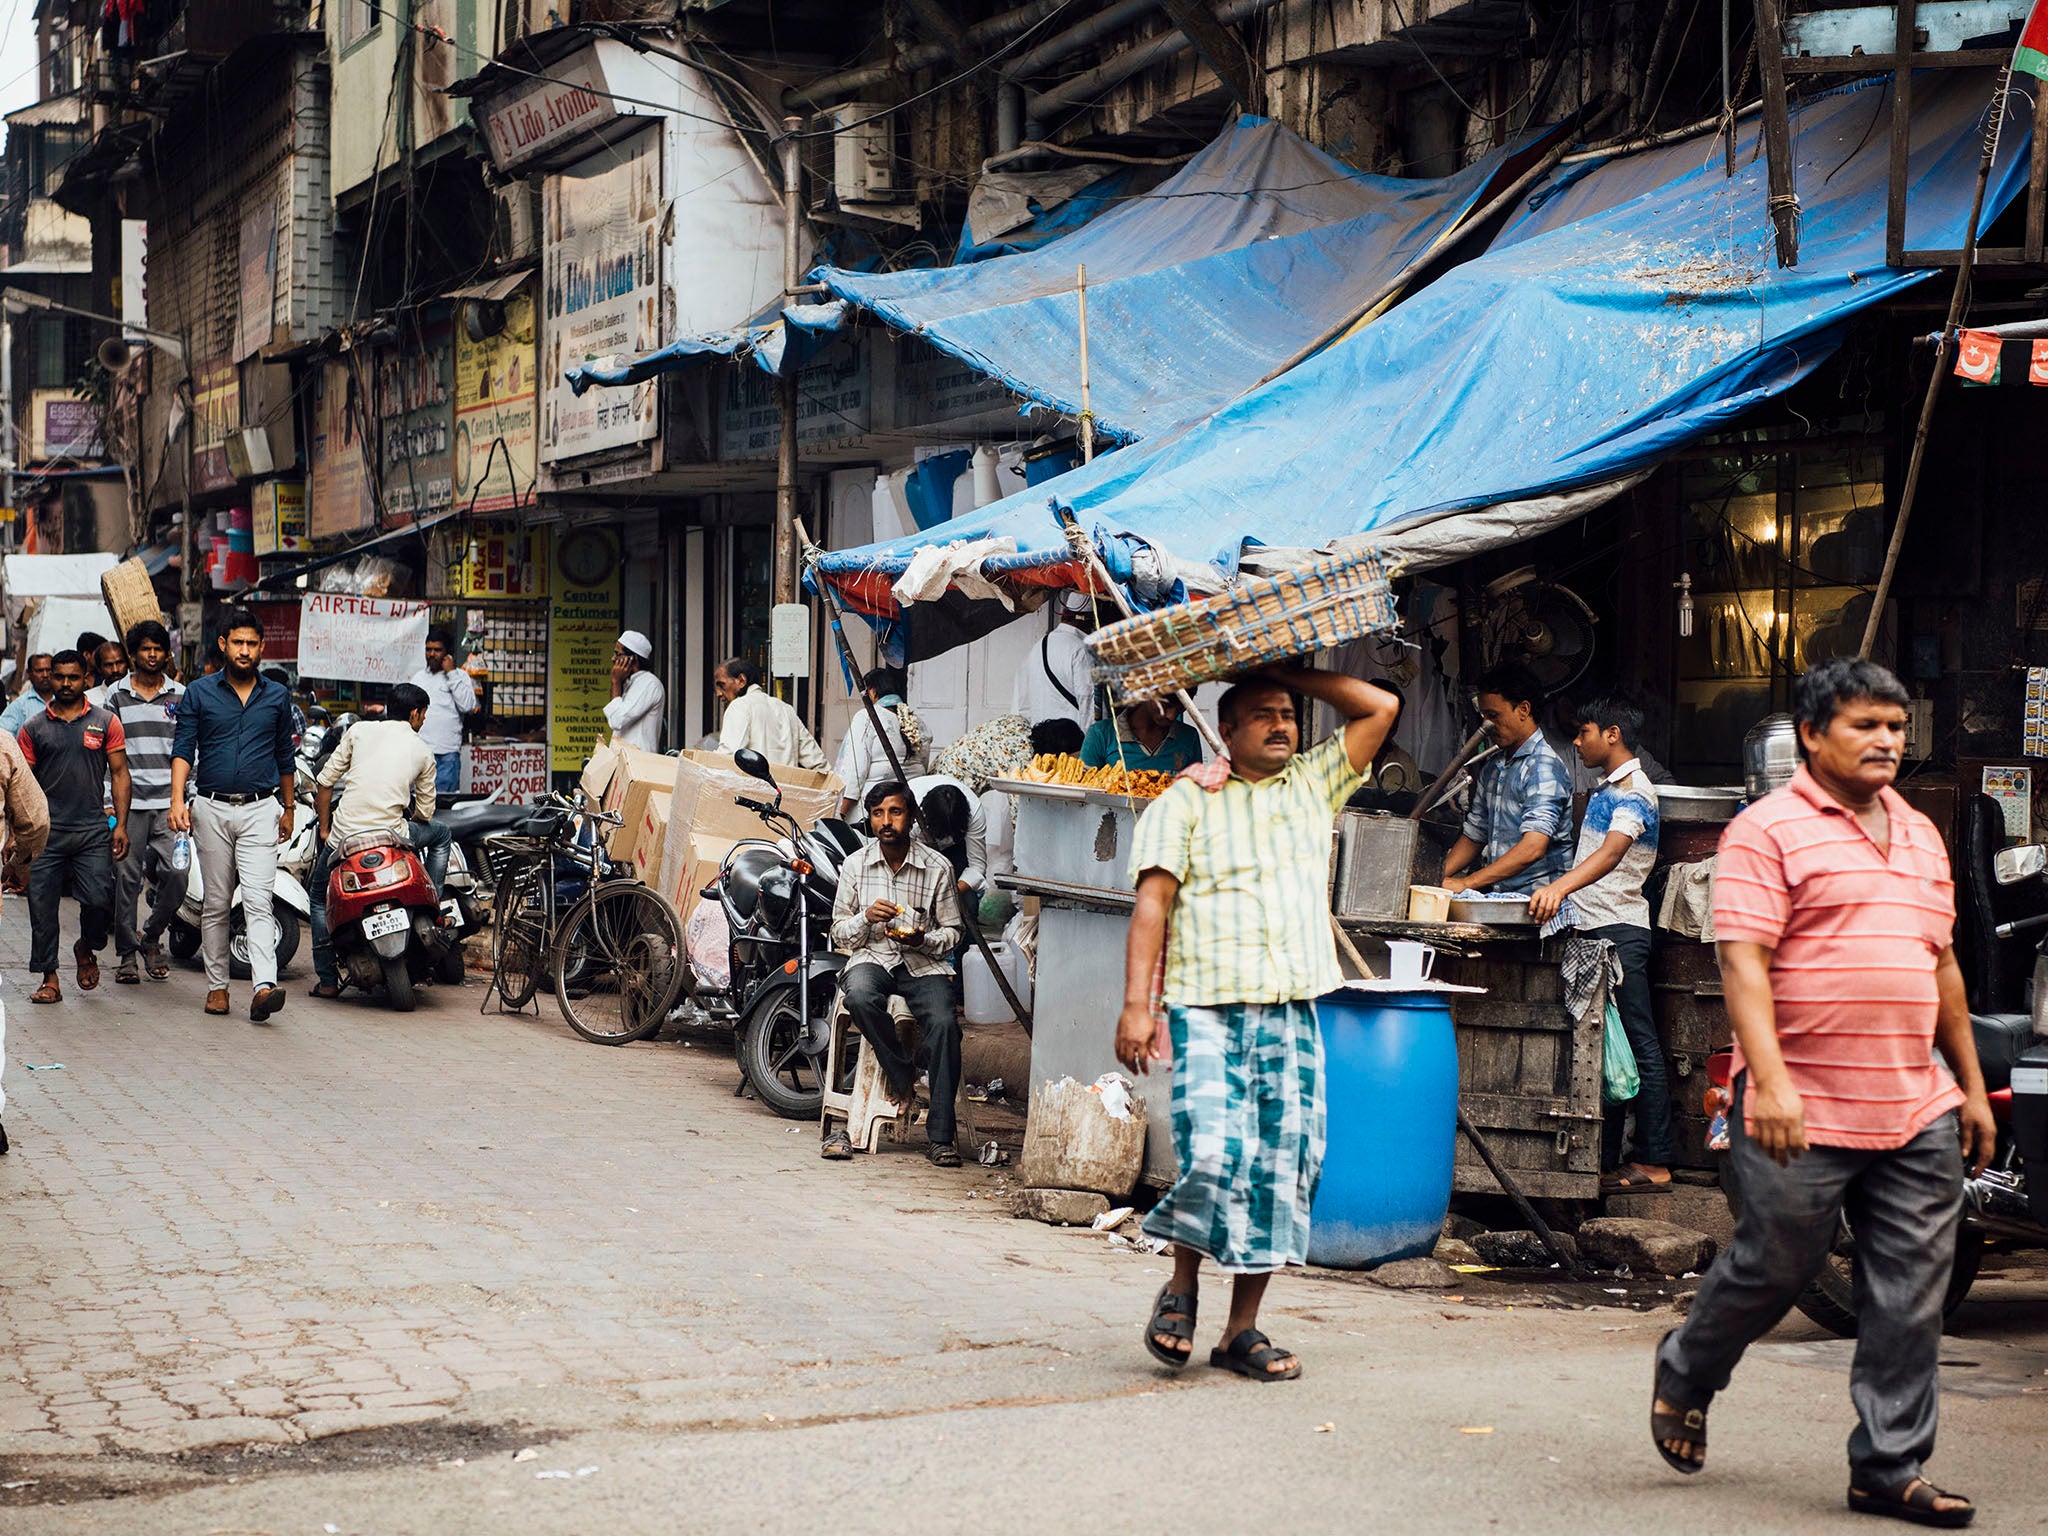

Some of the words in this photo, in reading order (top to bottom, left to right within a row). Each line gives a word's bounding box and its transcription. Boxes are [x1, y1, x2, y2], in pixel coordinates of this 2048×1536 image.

[507, 102, 546, 148] Lido
[544, 81, 599, 132] Aroma
[567, 260, 591, 314] Lido
[592, 251, 634, 306] Aroma
[471, 414, 494, 439] Central
[496, 408, 532, 435] Perfumers
[563, 590, 610, 603] Central
[309, 595, 381, 616] AIRTEL
[553, 605, 619, 619] Perfumers
[571, 648, 602, 656] IMPORT
[571, 658, 601, 666] EXPORT
[561, 667, 592, 675] WHOLE
[572, 678, 600, 686] RETAIL
[566, 725, 606, 733] ORIENTAL
[555, 745, 580, 753] FANCY
[510, 759, 546, 774] OFFER
[509, 776, 546, 796] COVER
